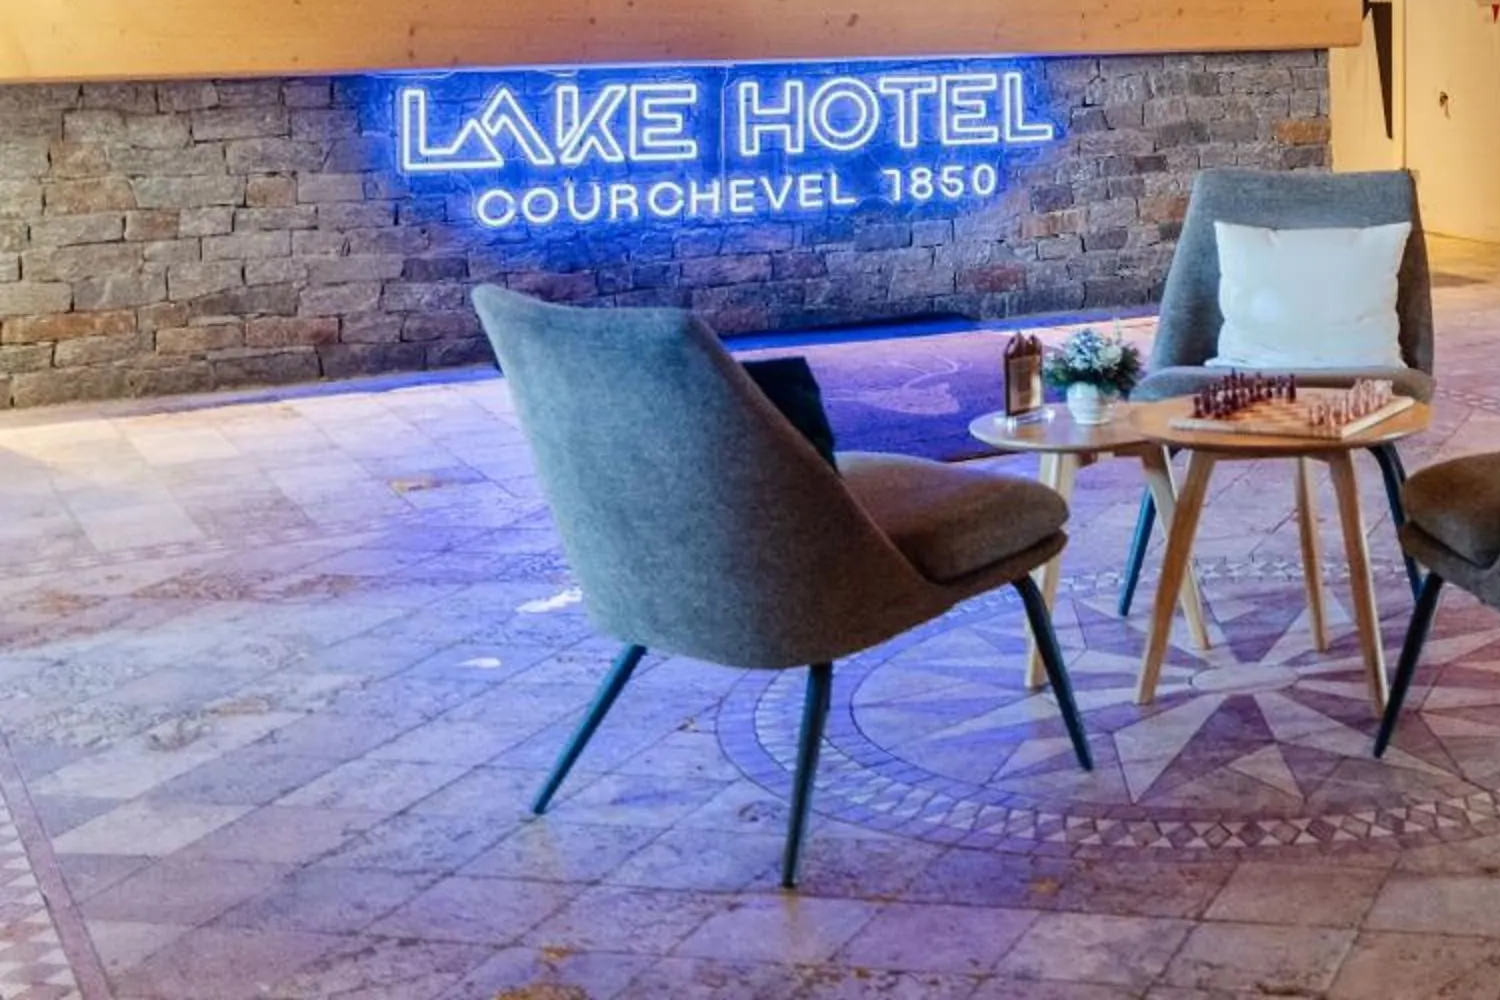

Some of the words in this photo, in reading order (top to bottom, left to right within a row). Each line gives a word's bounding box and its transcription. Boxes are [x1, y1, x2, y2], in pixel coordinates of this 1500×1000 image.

[401, 83, 698, 171] LAKE
[738, 71, 1055, 157] HOTEL
[476, 171, 858, 228] COURCHEVEL
[882, 162, 997, 202] 1850
